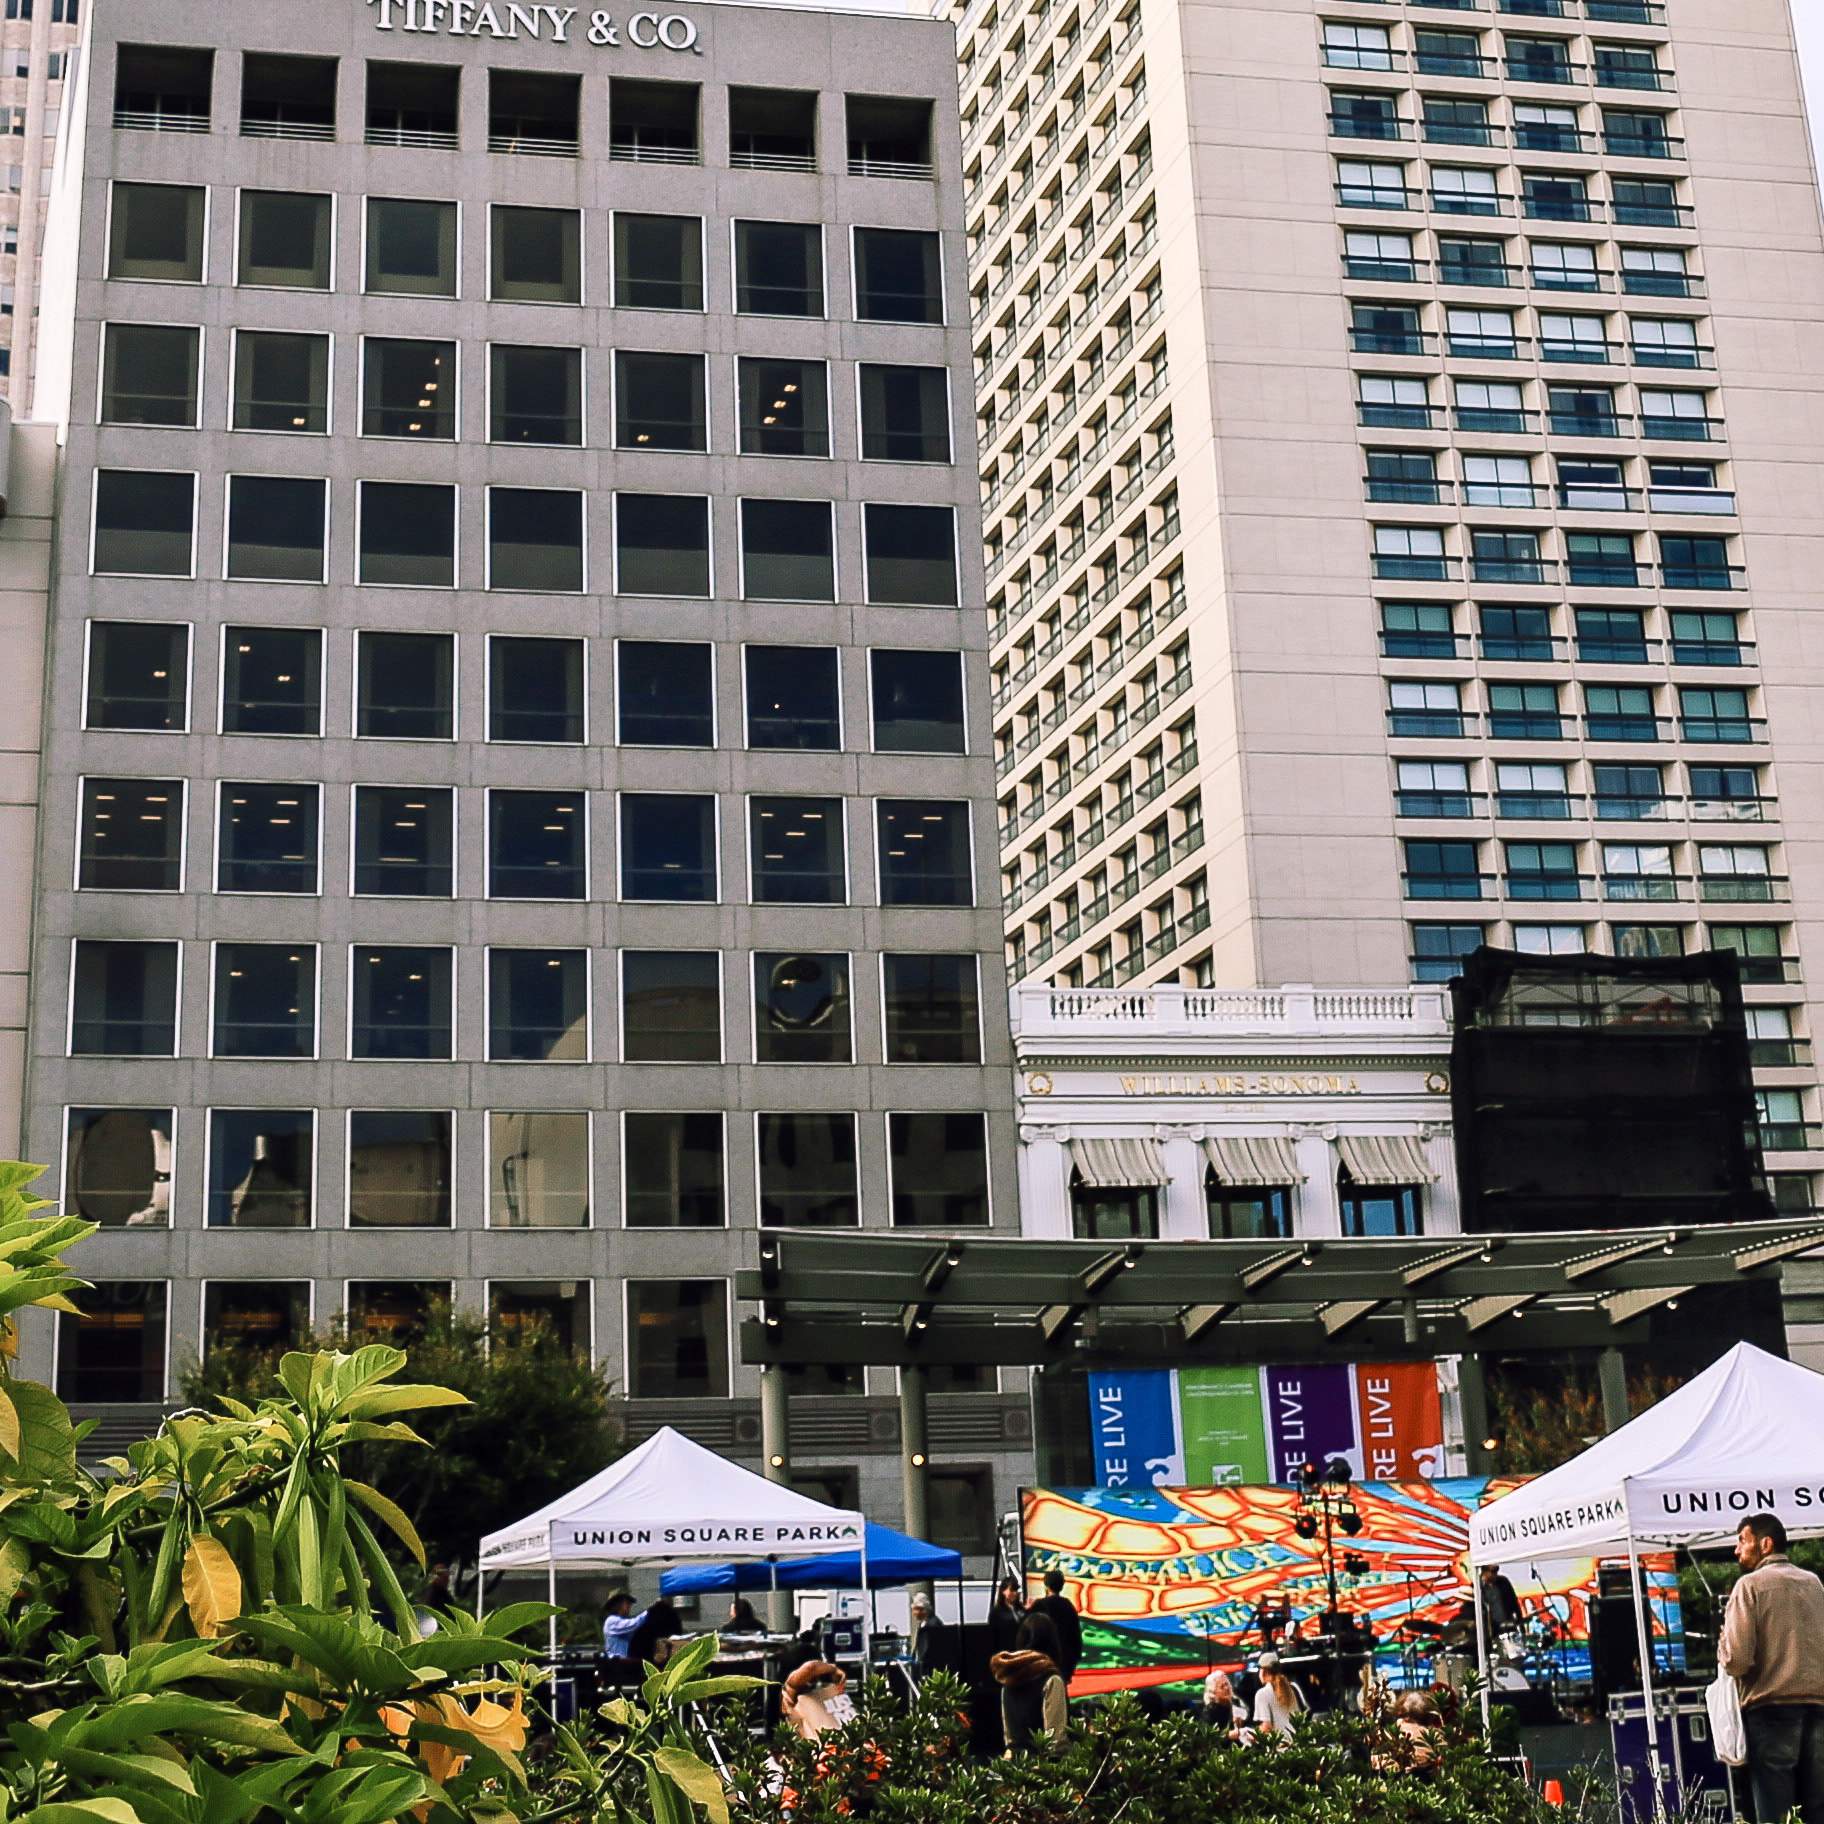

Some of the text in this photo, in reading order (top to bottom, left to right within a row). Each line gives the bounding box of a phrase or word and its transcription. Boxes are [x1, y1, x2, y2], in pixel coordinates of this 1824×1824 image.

[587, 9, 621, 46] &
[1120, 1076, 1361, 1095] WILLIAMS-SONOMA
[1099, 1387, 1126, 1447] LIVE
[1278, 1381, 1305, 1440] LIVE
[1366, 1378, 1394, 1438] LIVE
[1664, 1488, 1777, 1514] UNION
[574, 1526, 840, 1545] UNION SQUARE PARK
[1479, 1503, 1615, 1545] UNION SQUARE PARK
